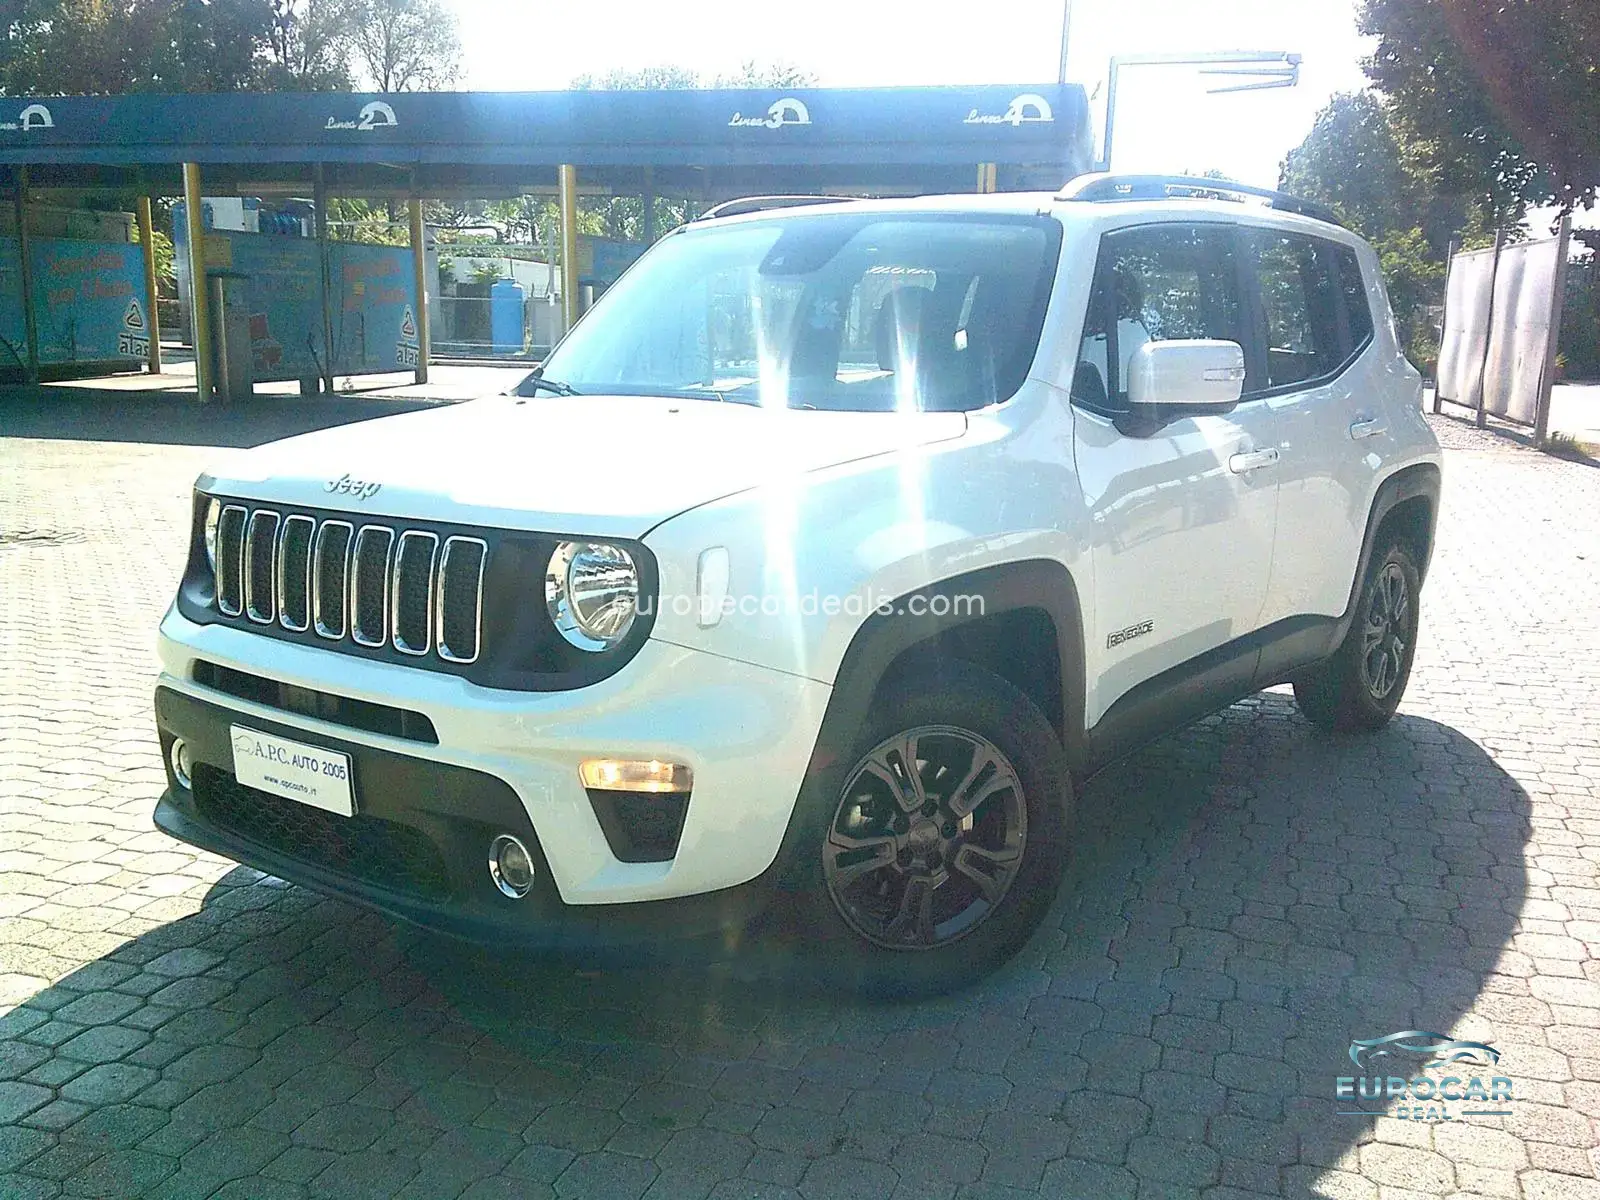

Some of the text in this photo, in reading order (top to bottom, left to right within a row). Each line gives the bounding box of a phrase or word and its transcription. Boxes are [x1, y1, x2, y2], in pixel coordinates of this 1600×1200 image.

[325, 101, 397, 130] Linea 2
[728, 97, 812, 129] Linea 3
[963, 93, 1056, 127] Linea 4
[322, 473, 382, 502] Jeep
[1107, 619, 1154, 649] RENEGADE
[254, 740, 347, 781] A.P.C. AUTO 2005
